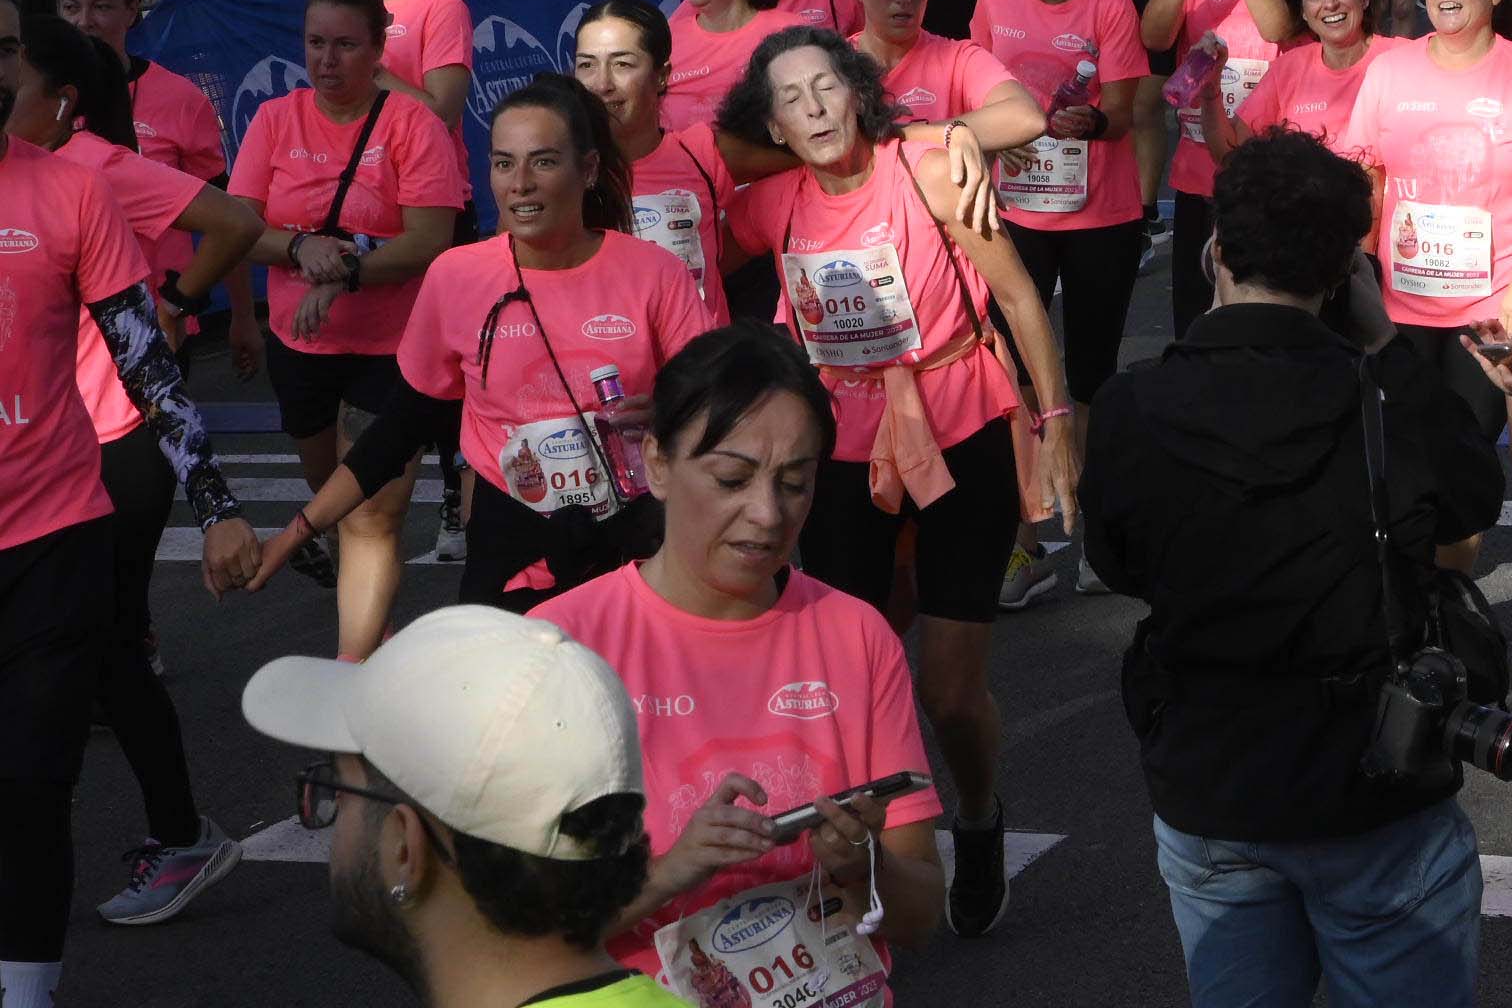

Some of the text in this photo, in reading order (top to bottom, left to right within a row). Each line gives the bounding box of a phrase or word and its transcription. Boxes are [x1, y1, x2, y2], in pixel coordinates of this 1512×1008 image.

[671, 66, 711, 82] OYSHO
[1027, 175, 1051, 184] 19058
[1394, 177, 1417, 200] TU
[1421, 240, 1454, 256] 016
[1424, 258, 1451, 269] 19082
[1427, 268, 1435, 277] DE
[1435, 269, 1444, 277] LA
[1444, 270, 1465, 279] MUJER
[825, 295, 866, 315] 016
[586, 322, 633, 334] ASTURIANA
[833, 317, 864, 330] 10020
[850, 331, 859, 340] LA
[860, 330, 884, 339] MUJER
[872, 337, 909, 355] Santander
[551, 467, 599, 490] 016
[559, 492, 597, 506] 18951
[719, 905, 792, 951] ASTURIANA
[748, 943, 815, 994] 016
